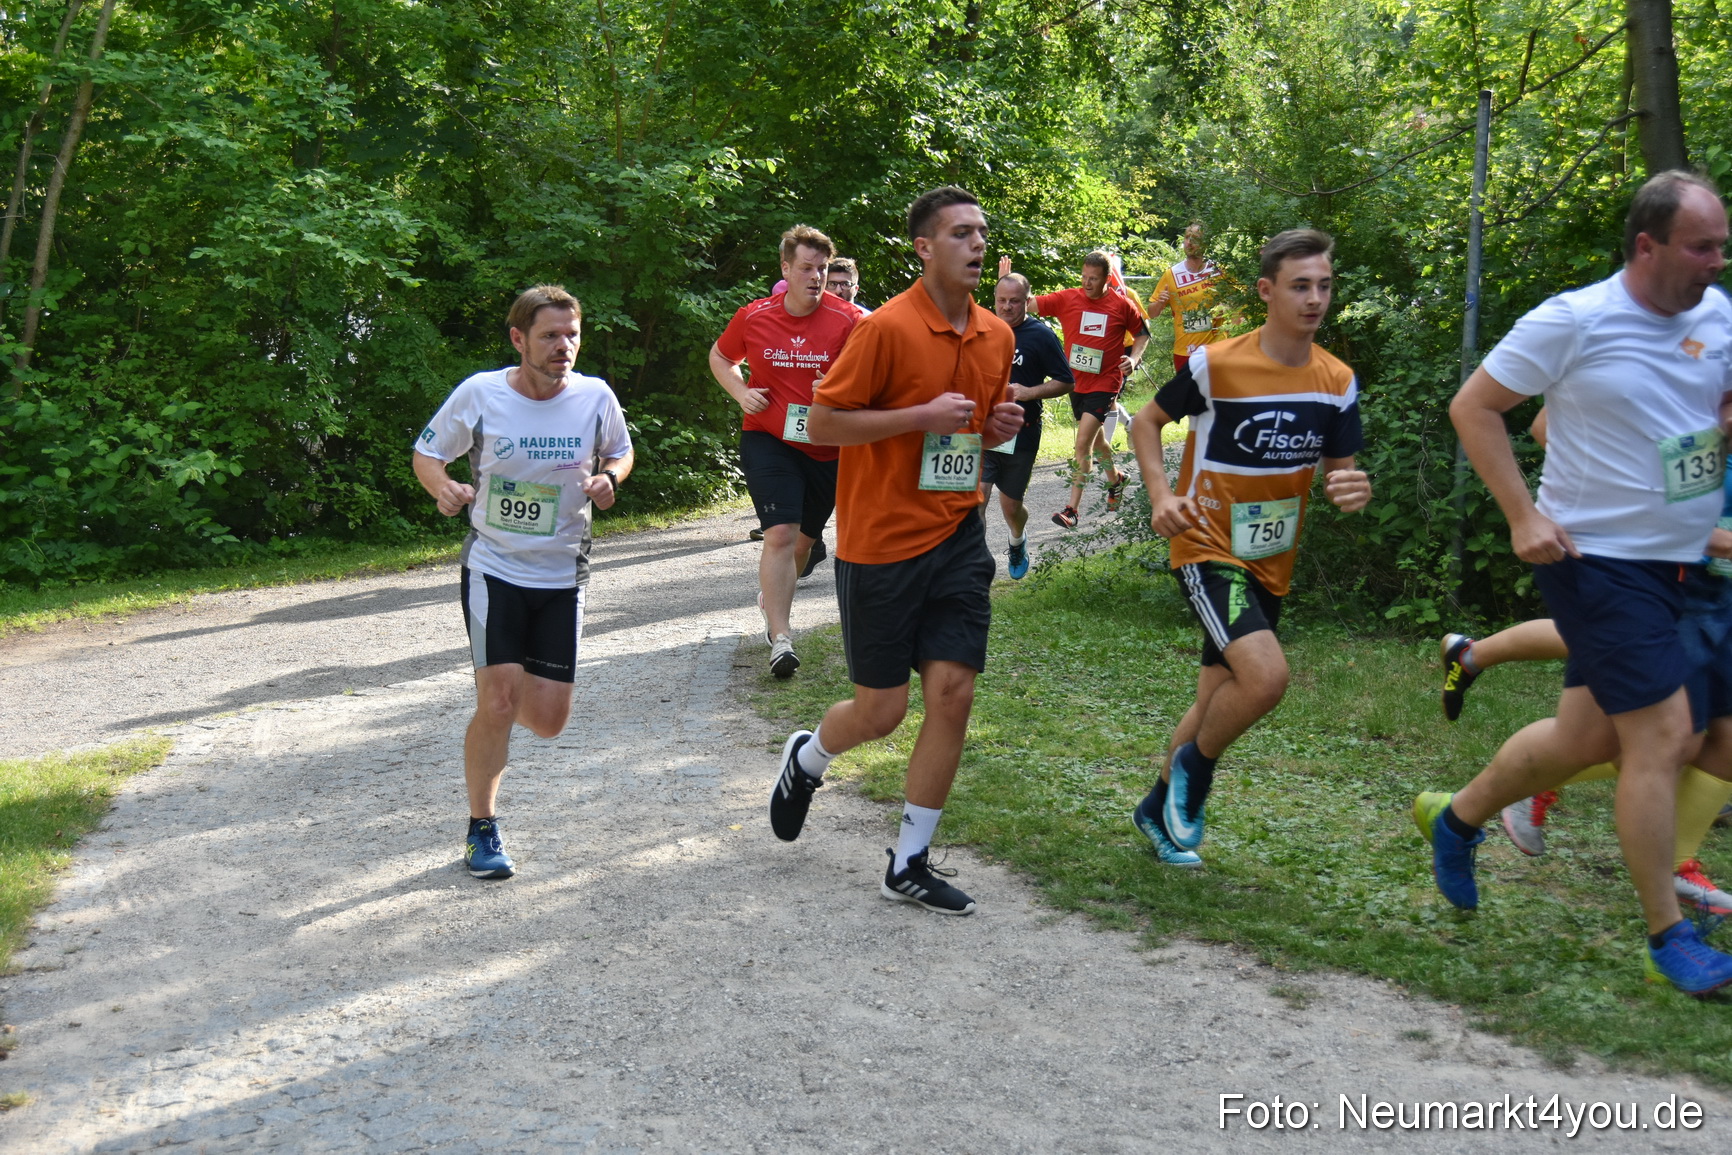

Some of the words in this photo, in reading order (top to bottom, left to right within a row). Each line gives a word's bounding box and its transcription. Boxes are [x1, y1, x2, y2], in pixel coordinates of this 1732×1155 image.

[1177, 286, 1199, 297] MAX
[763, 348, 789, 360] Echtes
[790, 350, 830, 362] Handwerk
[1012, 348, 1024, 366] is
[1075, 353, 1093, 366] 551
[795, 418, 808, 432] 5
[519, 437, 582, 448] HAUBNER
[527, 450, 575, 460] TREPPEN
[931, 453, 974, 475] 1803
[500, 498, 541, 521] 999
[1248, 520, 1285, 544] 750
[1444, 661, 1462, 691] FILA
